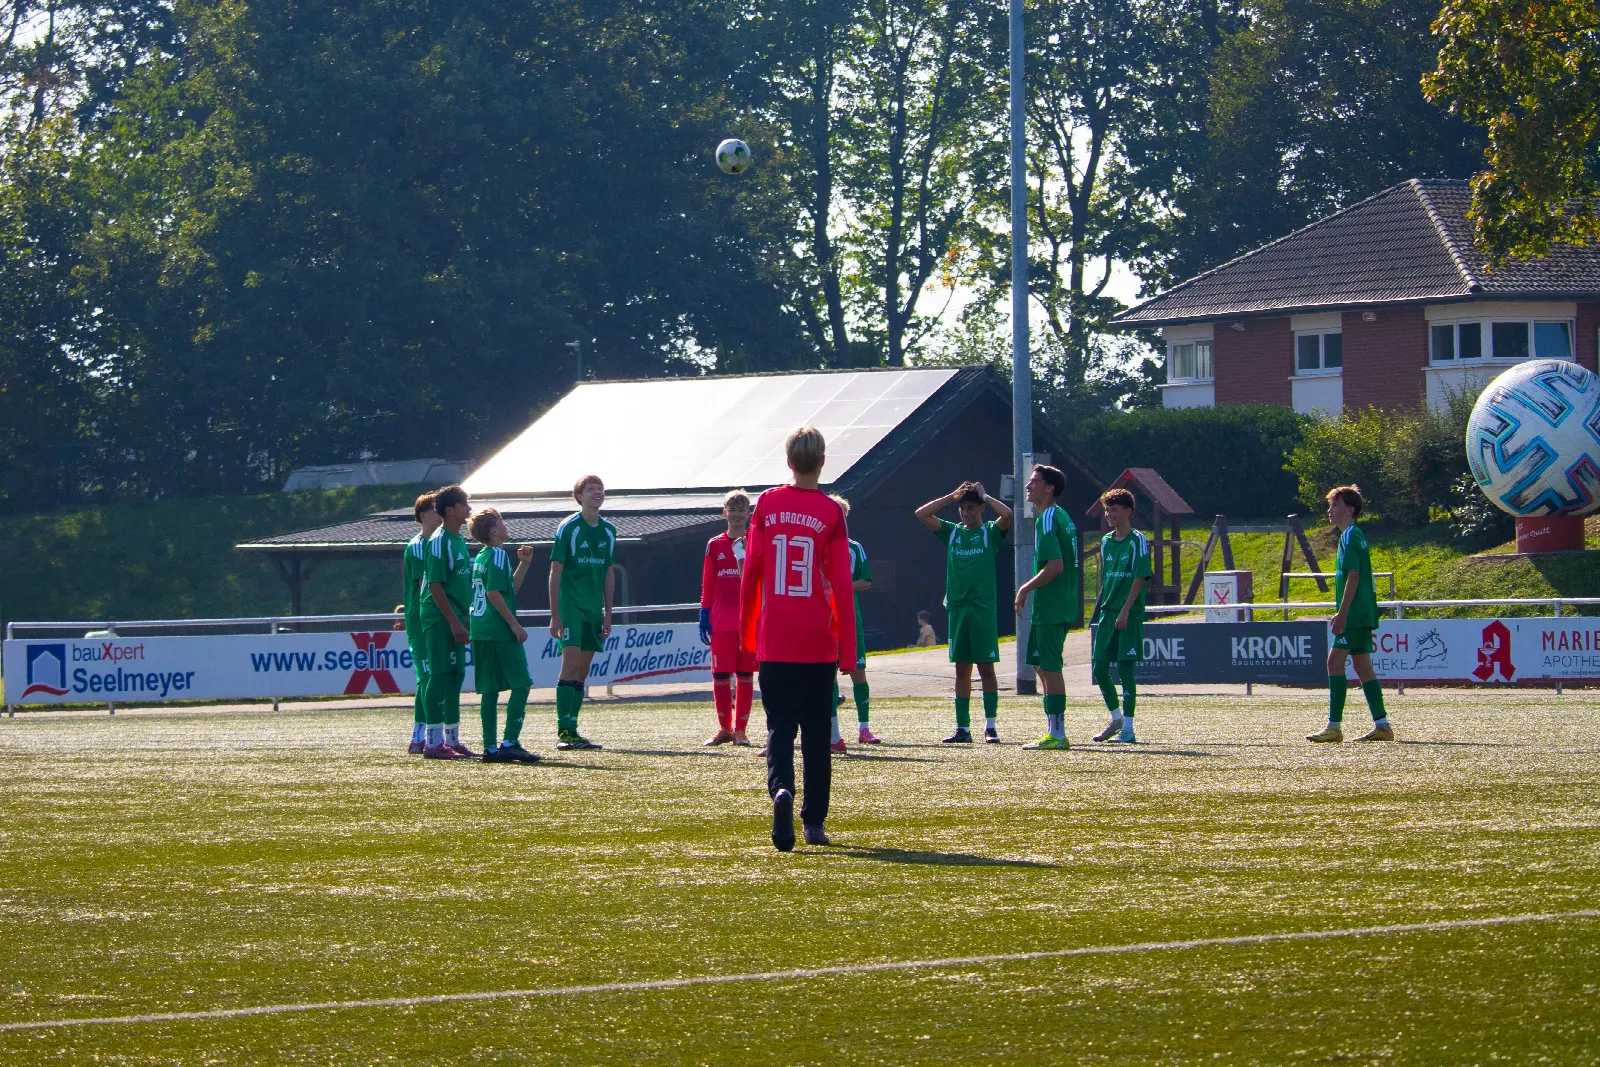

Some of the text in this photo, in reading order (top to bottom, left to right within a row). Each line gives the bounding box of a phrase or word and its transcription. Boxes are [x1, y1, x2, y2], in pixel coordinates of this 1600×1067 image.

[780, 511, 827, 534] BROCKDORF
[772, 534, 815, 598] 13
[625, 628, 674, 649] Bauen
[1143, 638, 1186, 660] ONE
[1231, 635, 1313, 659] KRONE
[1371, 633, 1409, 653] SCH
[1542, 630, 1600, 651] MARIE
[72, 642, 146, 663] bauXpert
[251, 643, 474, 673] www.seelmed
[614, 646, 710, 675] Modernisier
[1542, 655, 1600, 668] APOTHE
[589, 654, 612, 678] nd
[72, 668, 195, 697] Seelmeyer
